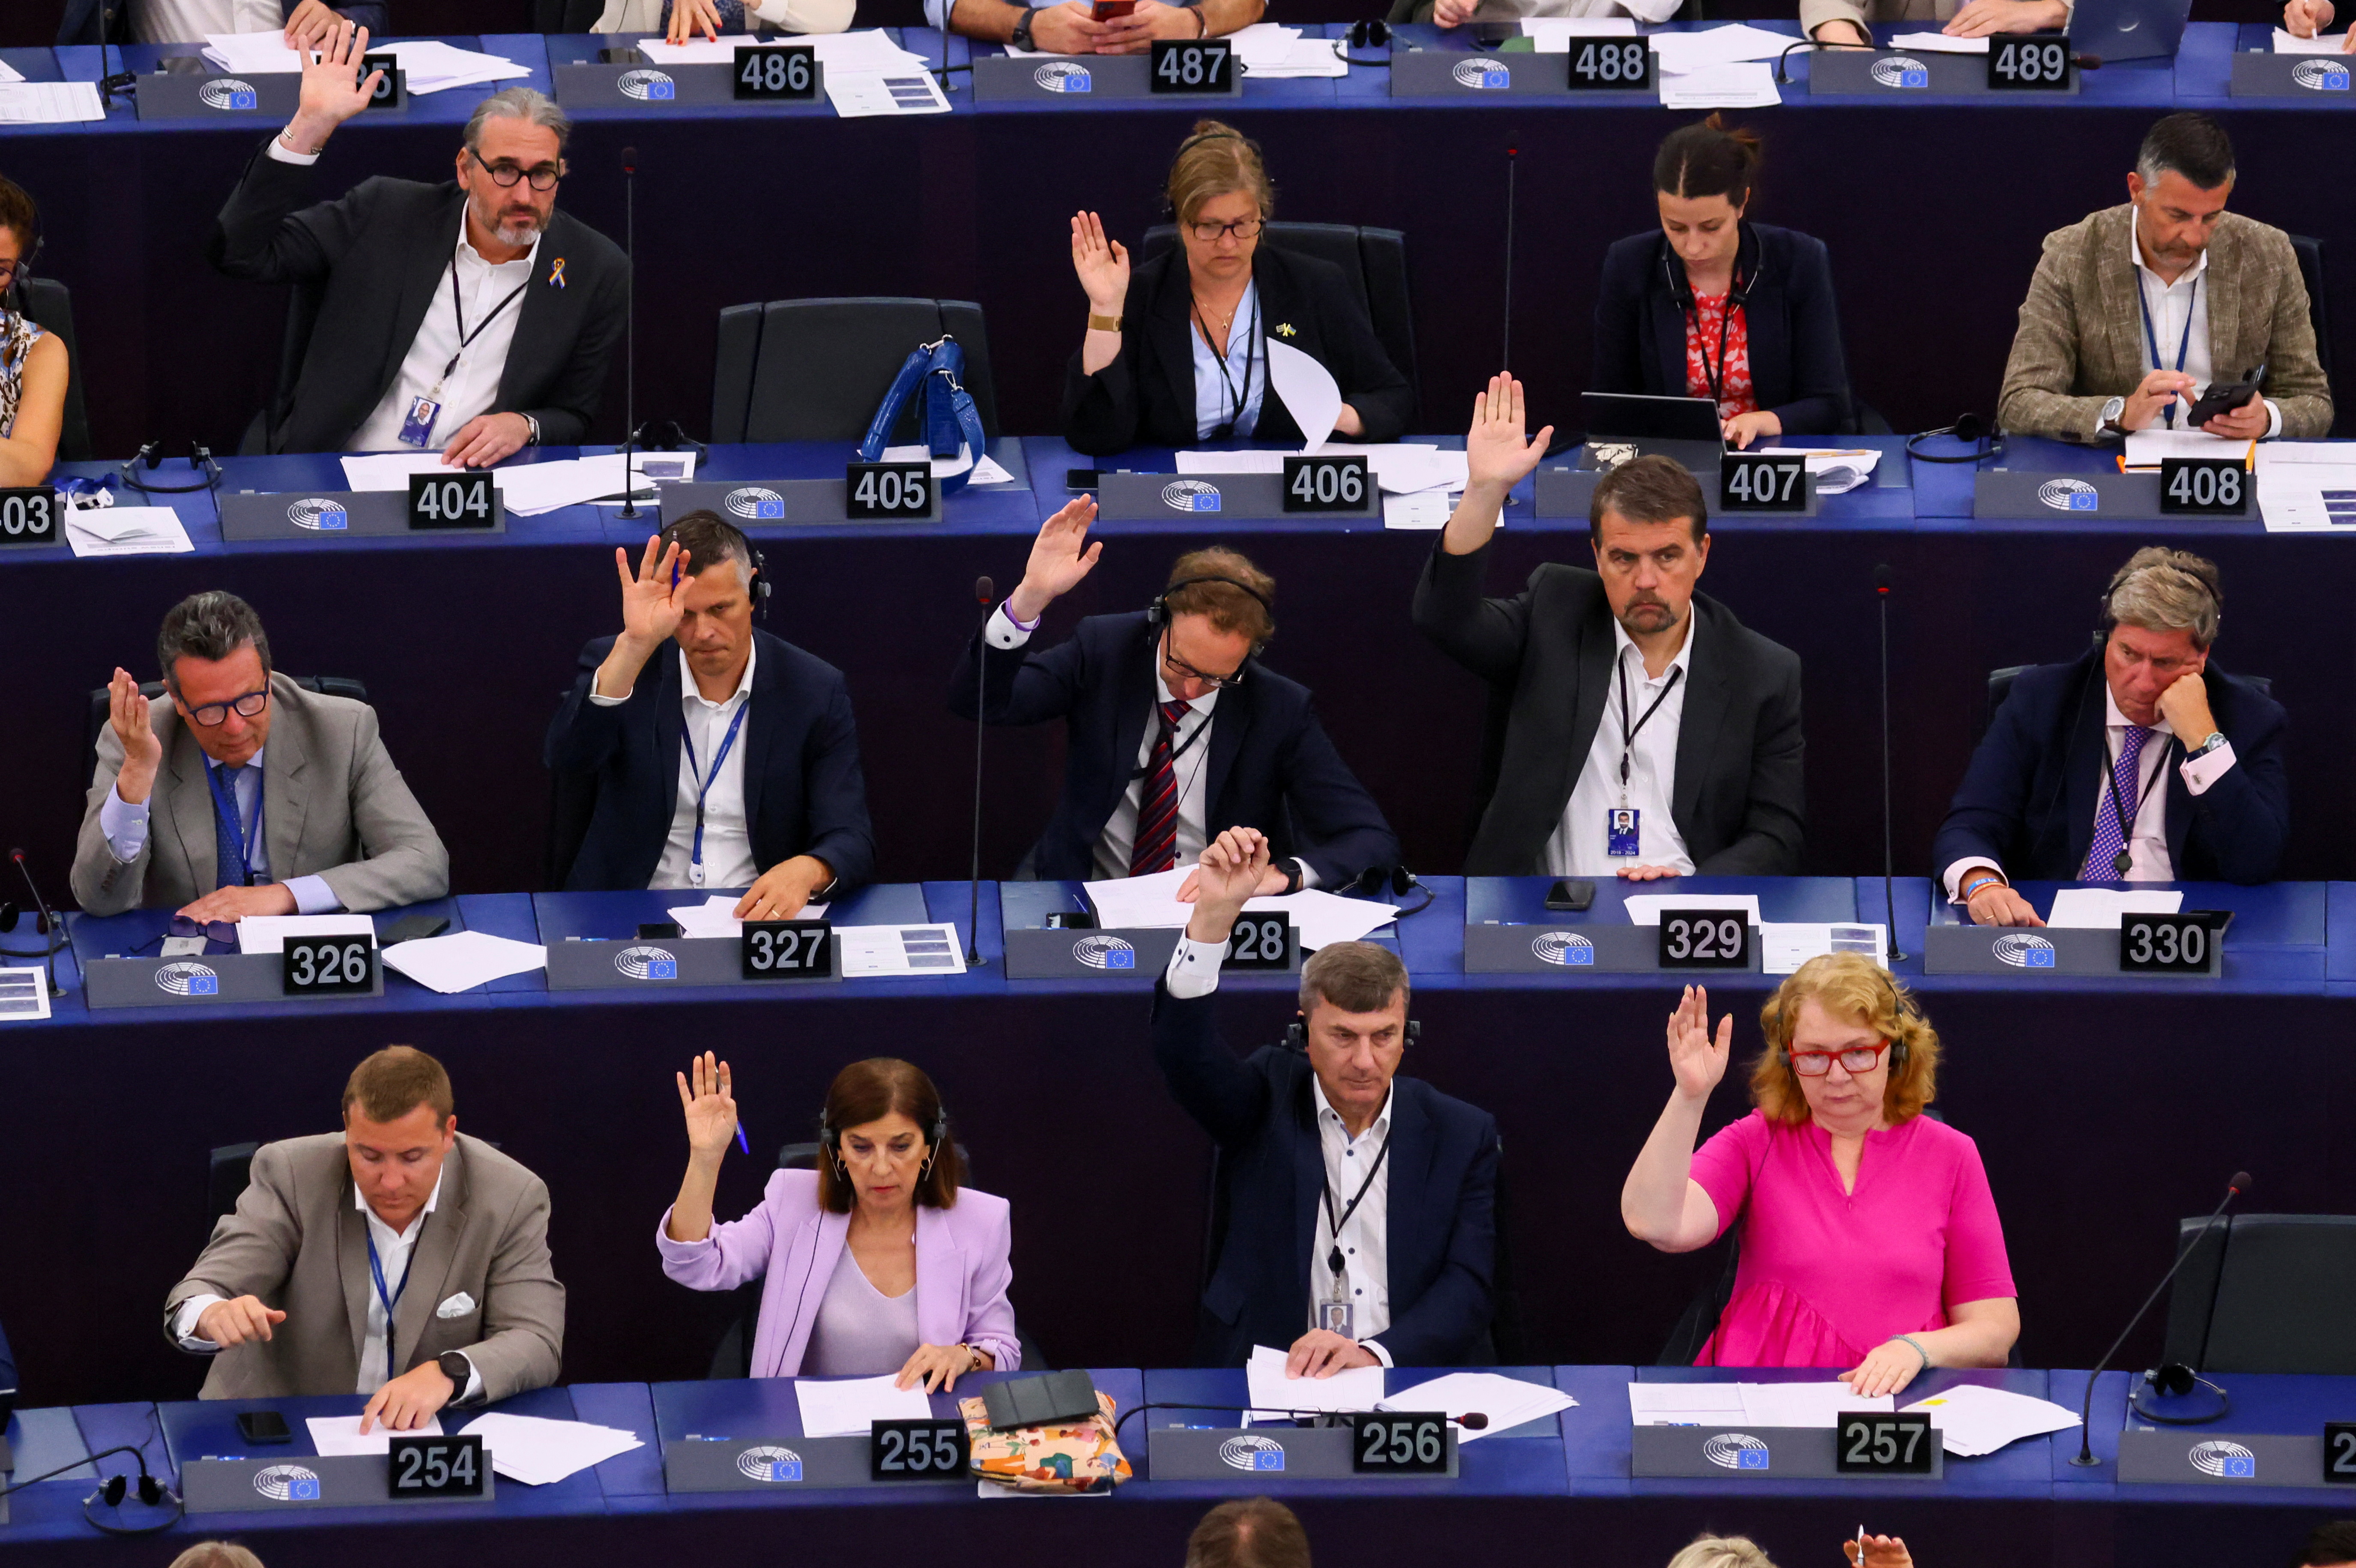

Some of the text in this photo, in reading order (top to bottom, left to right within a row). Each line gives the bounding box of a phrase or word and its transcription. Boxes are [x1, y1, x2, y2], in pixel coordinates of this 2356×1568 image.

[741, 54, 809, 90] 486
[1158, 48, 1226, 84] 487
[1576, 44, 1644, 81] 488
[1996, 44, 2064, 81] 489
[417, 481, 488, 520] 404
[855, 471, 925, 509] 405
[1292, 464, 1362, 502] 406
[1729, 464, 1800, 502] 407
[2169, 467, 2240, 505] 408
[0, 496, 50, 535] 03
[751, 929, 825, 970] 327
[1222, 921, 1283, 960] 28
[1668, 919, 1742, 959] 329
[2130, 923, 2204, 964] 330
[292, 944, 366, 985] 326
[881, 1429, 958, 1470] 255
[1363, 1422, 1440, 1463] 256
[1846, 1422, 1925, 1463] 257
[398, 1445, 476, 1487] 254
